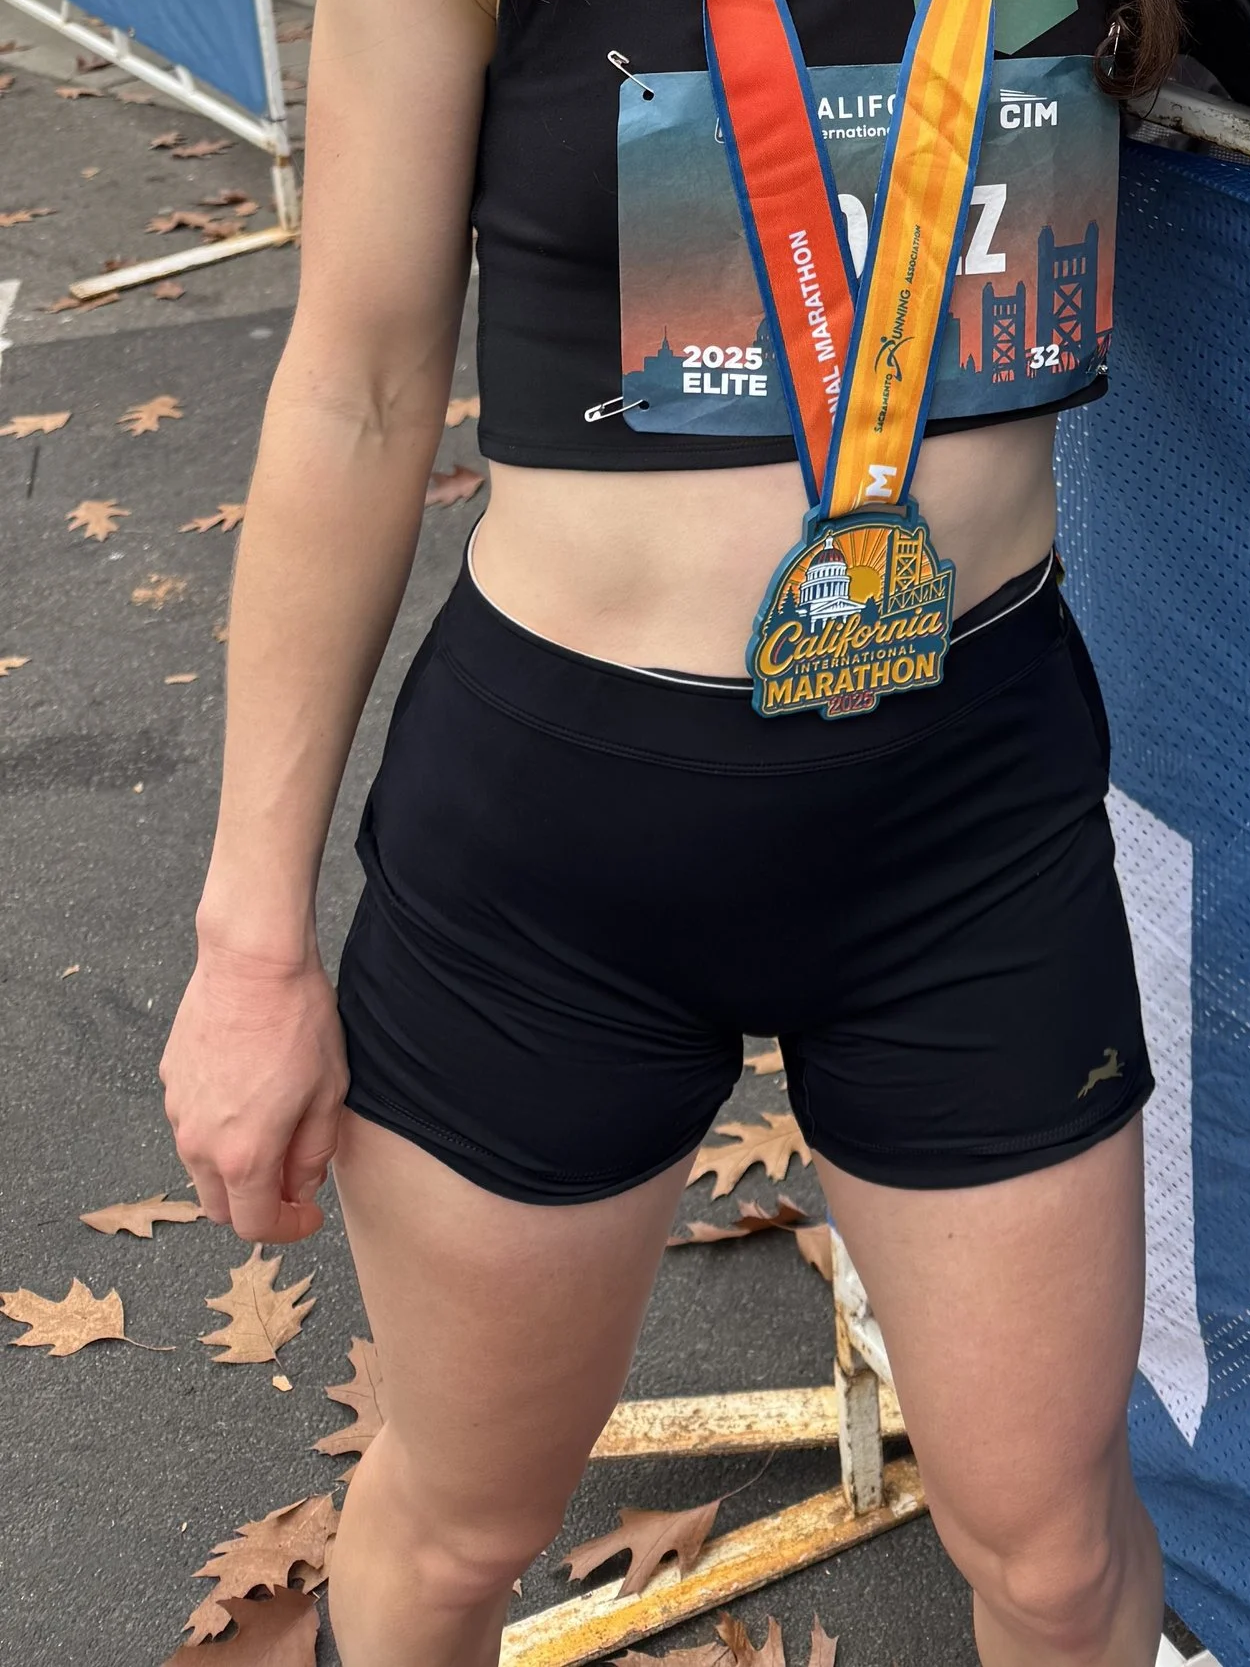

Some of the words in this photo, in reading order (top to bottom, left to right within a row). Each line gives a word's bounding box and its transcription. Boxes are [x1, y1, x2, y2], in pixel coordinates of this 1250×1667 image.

[1000, 101, 1057, 130] CIM
[789, 230, 837, 362] MARATHON
[682, 345, 763, 370] 2025
[1030, 344, 1060, 369] 32
[683, 372, 767, 396] ELITE
[759, 607, 944, 676] California
[795, 644, 916, 675] INTERNATIONAL
[766, 651, 936, 709] MARATHON
[829, 691, 875, 716] 2025
